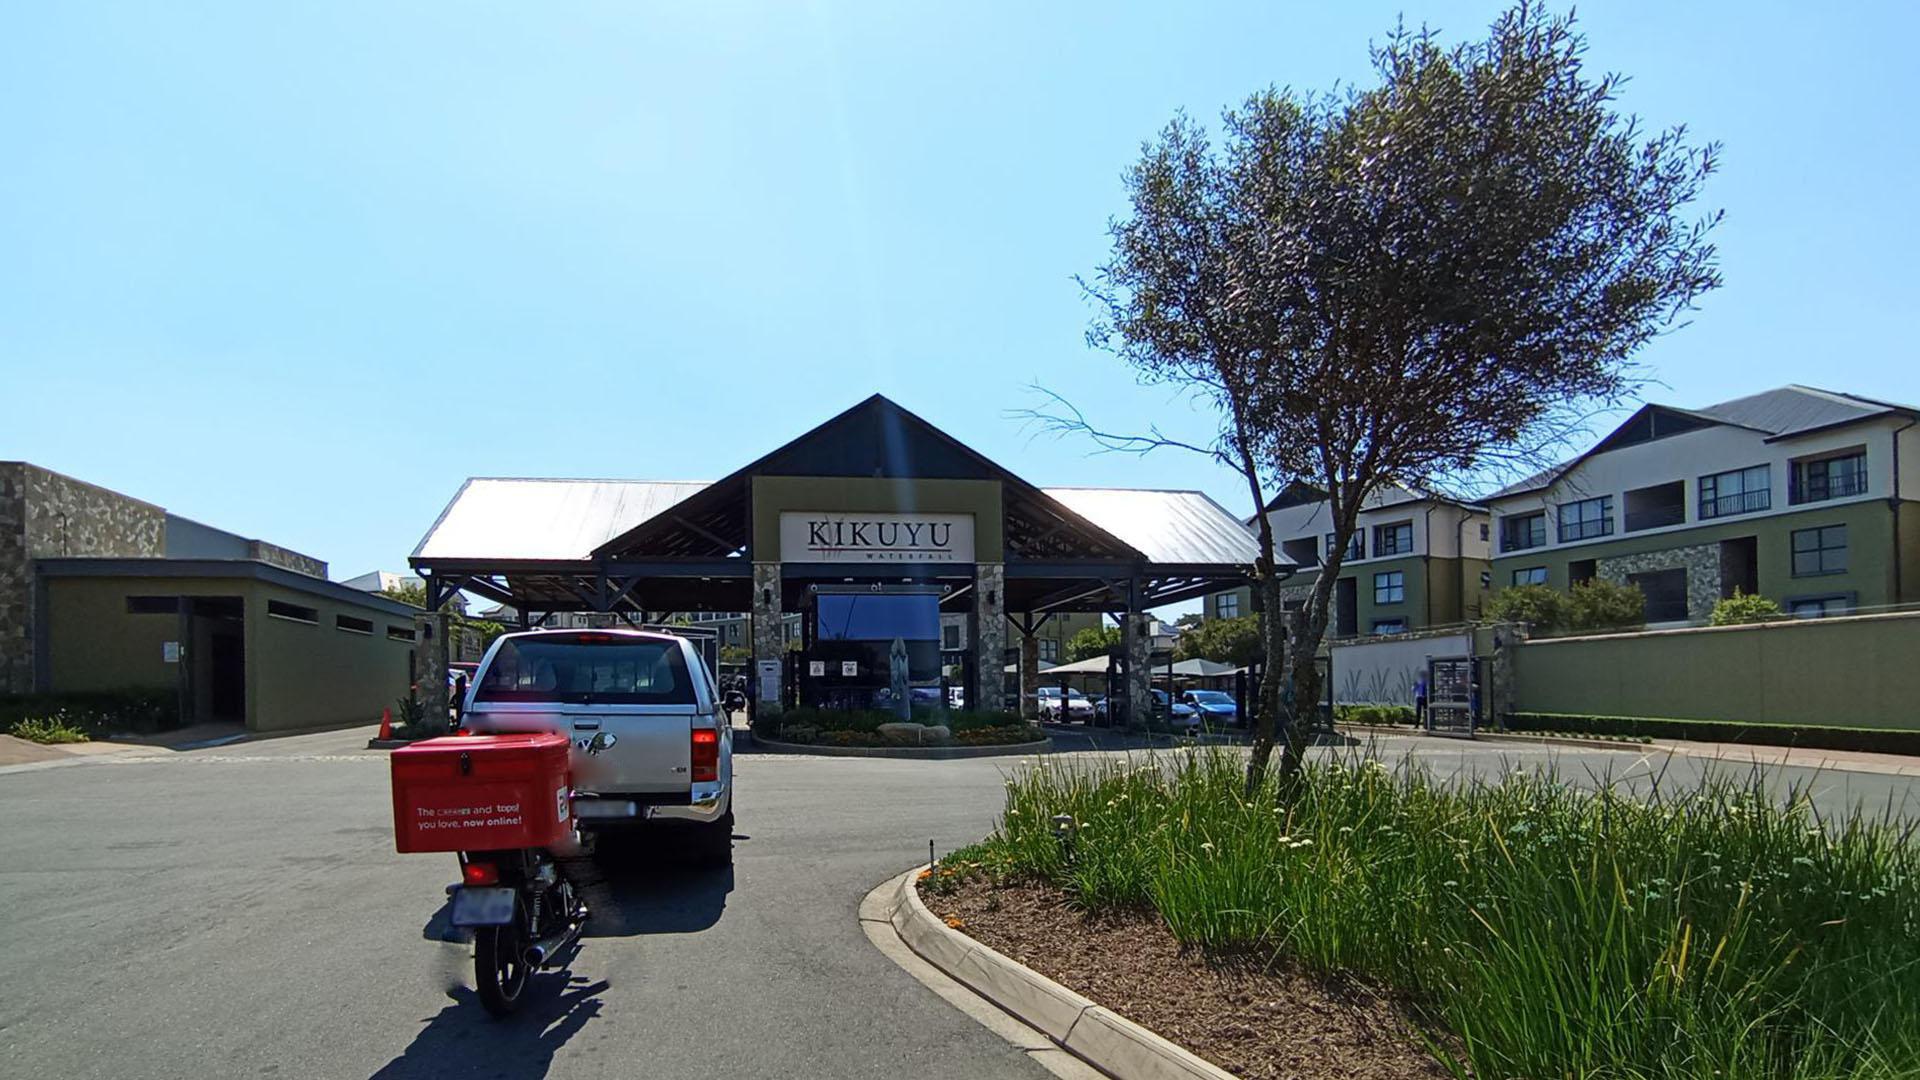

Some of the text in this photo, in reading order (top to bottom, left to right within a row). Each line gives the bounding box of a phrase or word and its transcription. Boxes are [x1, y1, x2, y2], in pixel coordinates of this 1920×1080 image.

[808, 521, 952, 547] KIKUYU
[417, 807, 435, 817] The
[473, 805, 492, 815] and
[418, 821, 436, 831] you
[463, 819, 484, 828] now
[486, 816, 522, 827] online!
